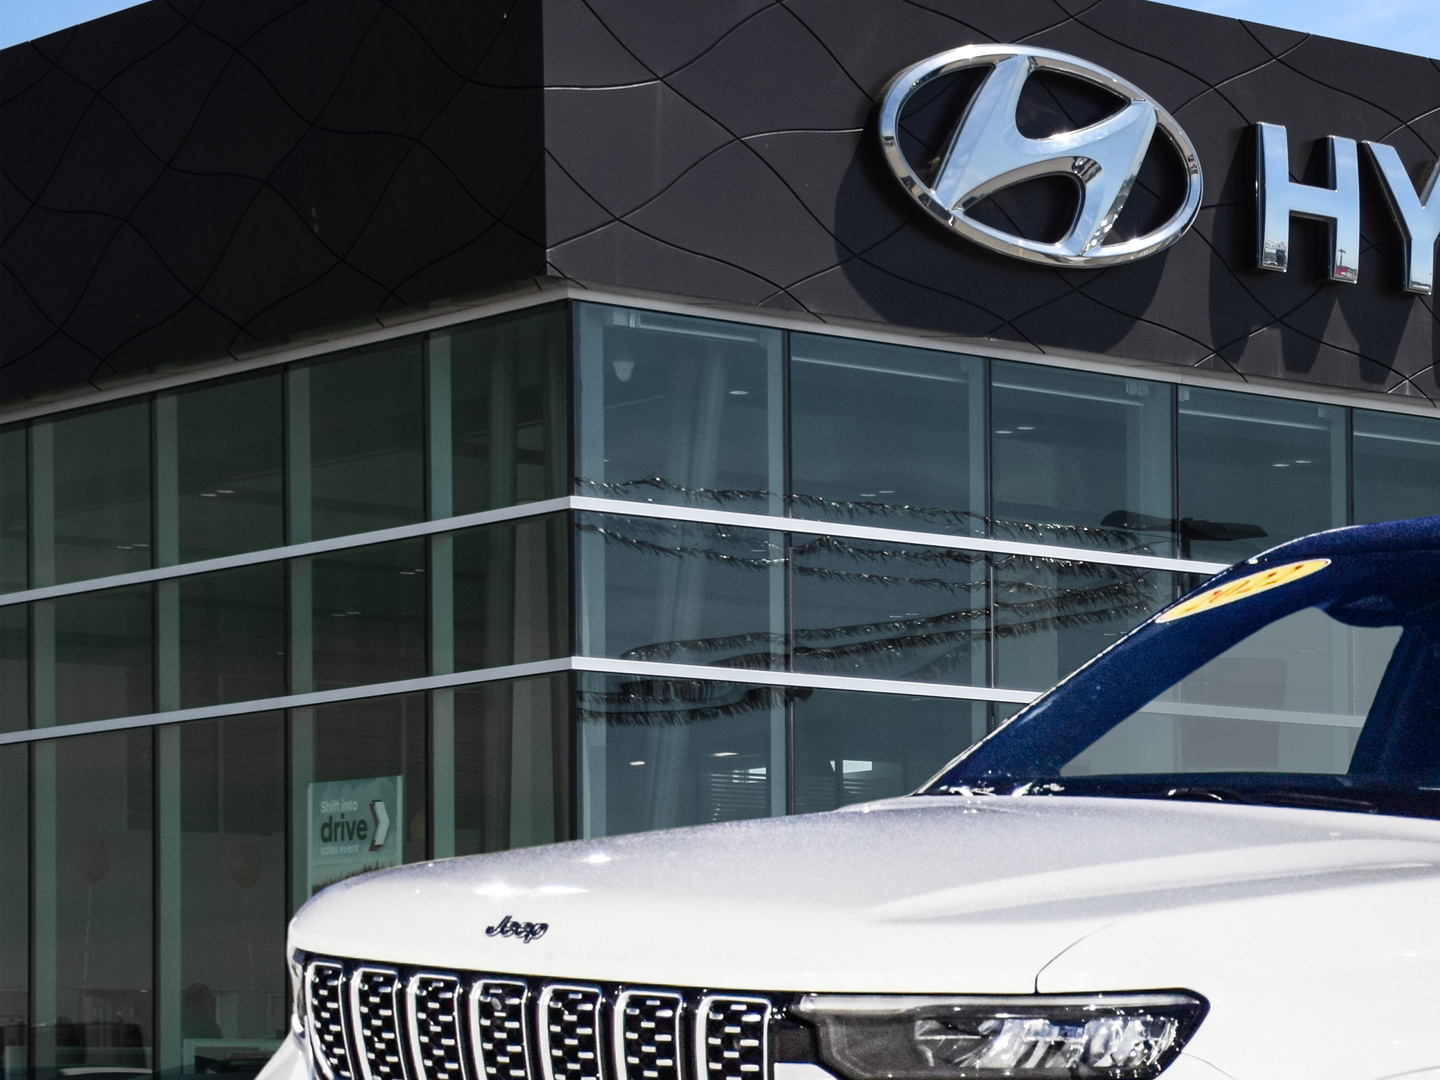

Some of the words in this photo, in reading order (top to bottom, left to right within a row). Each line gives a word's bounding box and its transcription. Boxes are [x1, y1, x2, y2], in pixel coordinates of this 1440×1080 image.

[320, 799, 340, 813] Shift
[340, 799, 359, 812] into
[320, 813, 368, 843] drive
[485, 915, 549, 944] Jeep
